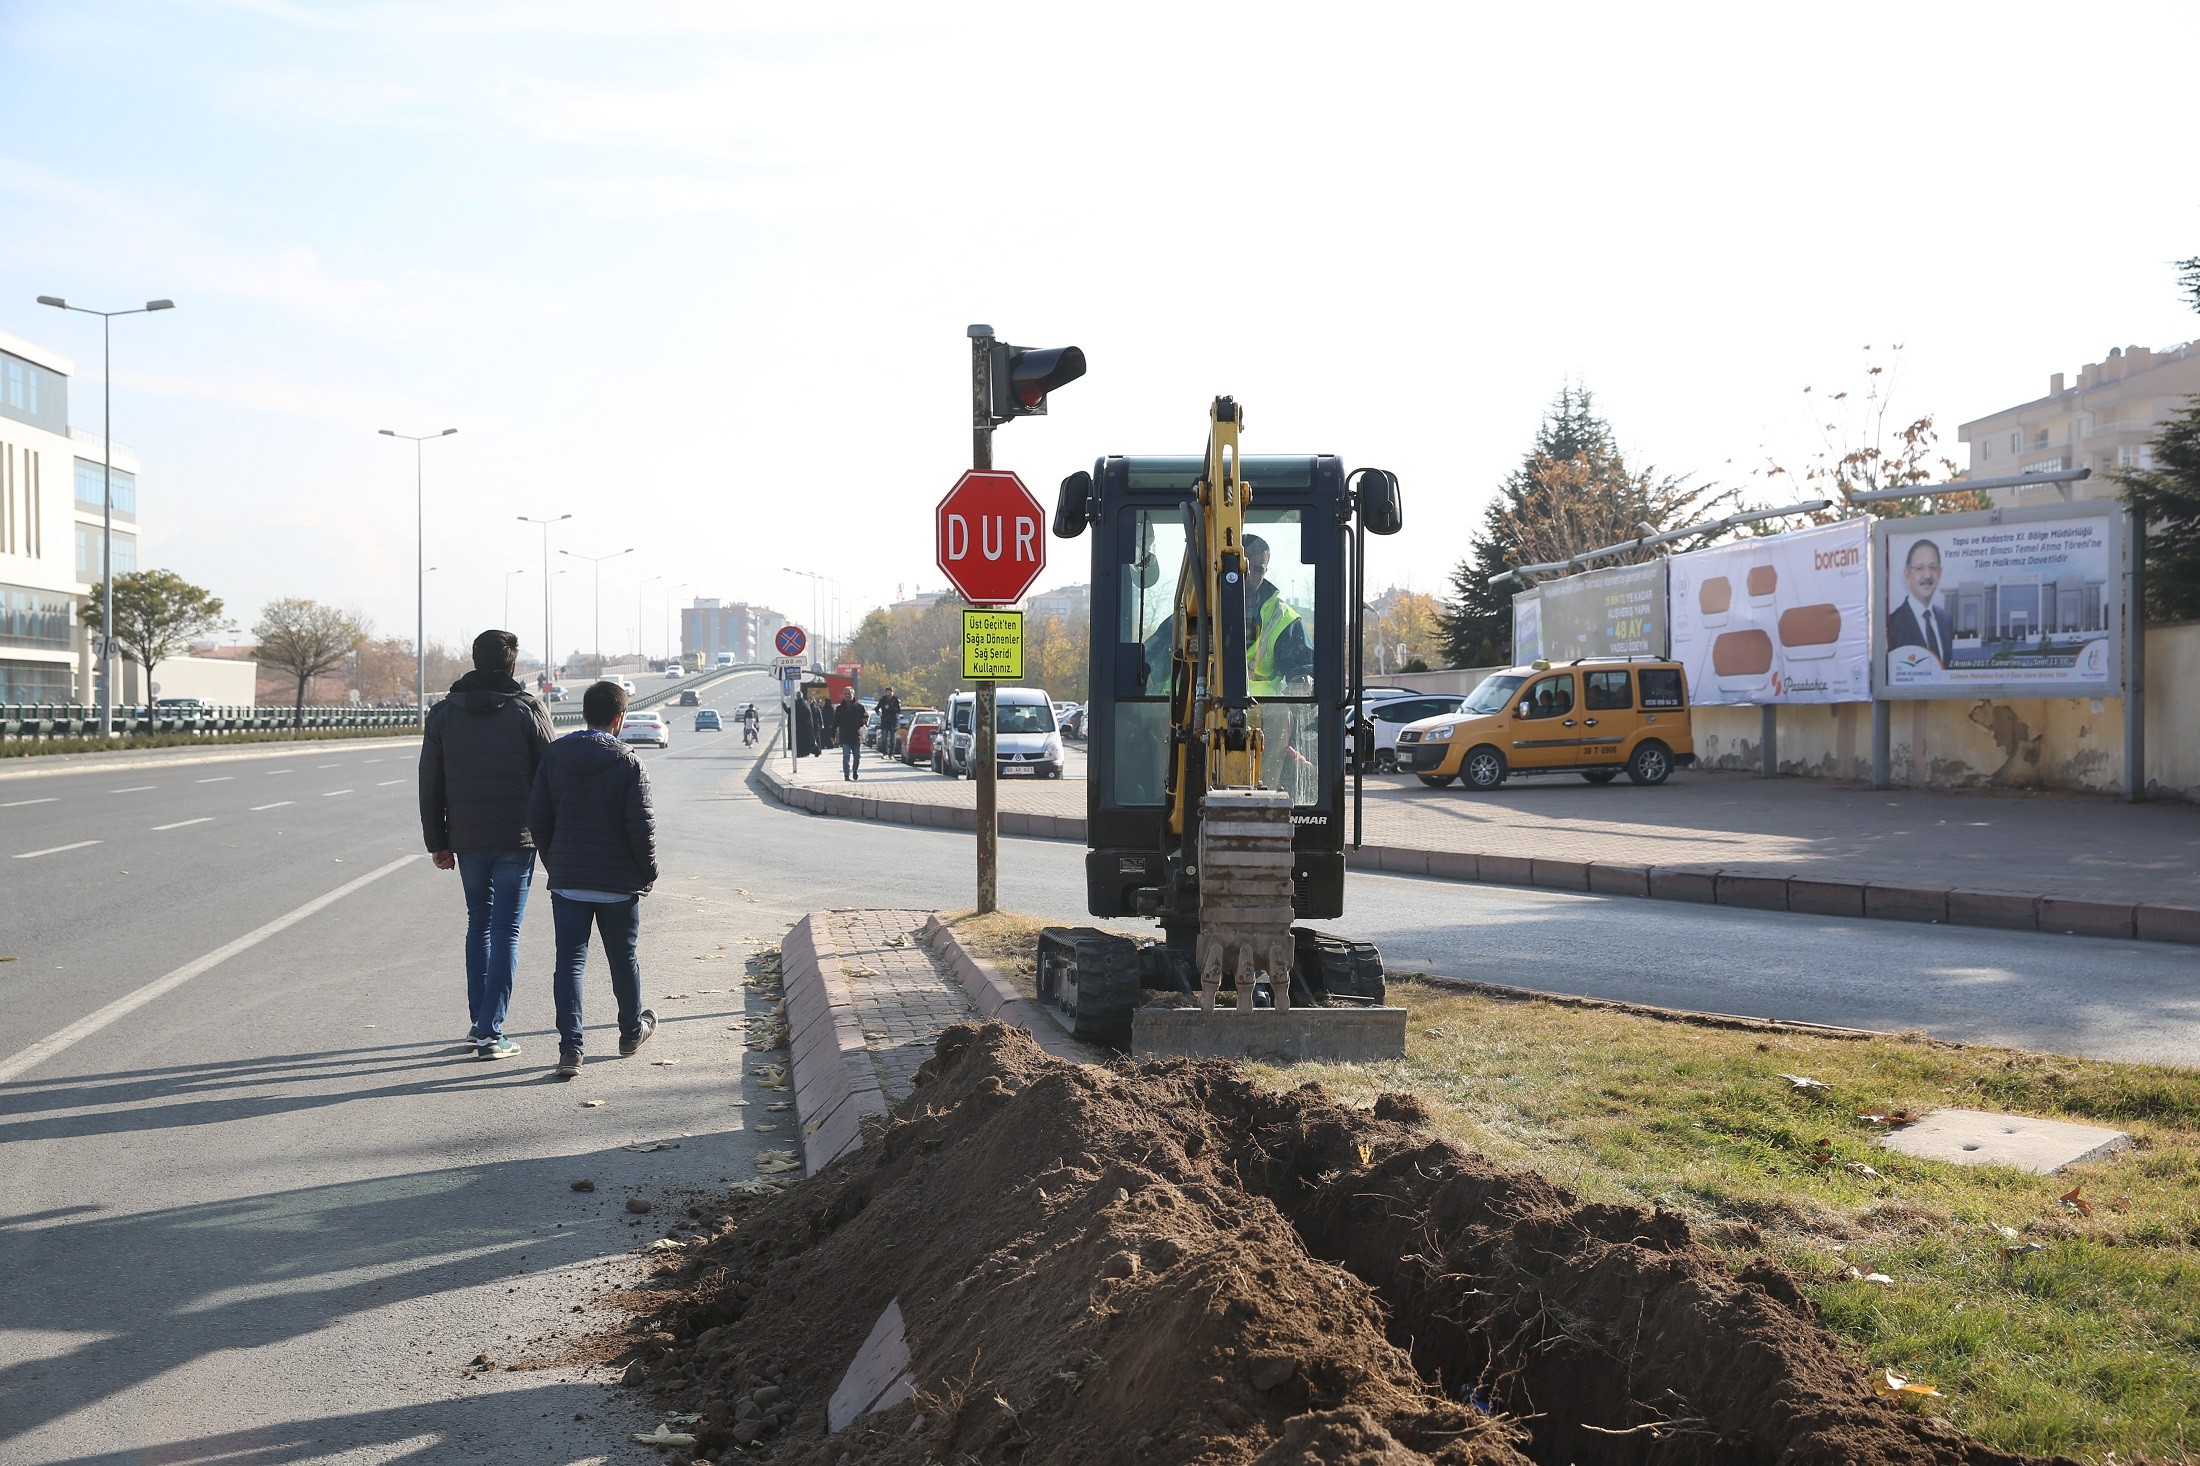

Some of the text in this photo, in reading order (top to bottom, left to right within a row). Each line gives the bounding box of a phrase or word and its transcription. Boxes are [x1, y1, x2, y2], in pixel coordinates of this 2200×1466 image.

[948, 513, 1036, 562] DUR
[1952, 537, 1970, 547] Tapu
[1970, 537, 1979, 545] ve
[1981, 534, 2014, 544] Kadastro
[2027, 530, 2048, 542] Bölge
[2050, 526, 2093, 539] Müdürlüğü
[1944, 538, 2102, 559] Yeni Hizmet Binası Temel Atma Töreni'ne
[1814, 547, 1859, 571] borcam
[1974, 553, 2068, 568] Tüm Halkımız Davetlidir
[969, 616, 1017, 631] Üst Geçit'ten
[1615, 618, 1643, 639] 48 AY
[966, 633, 1020, 646] Sağa Dönenler
[974, 648, 1012, 660] Sağ Şeridi
[973, 662, 1013, 674] Kullanınız.
[1594, 746, 1599, 754] T
